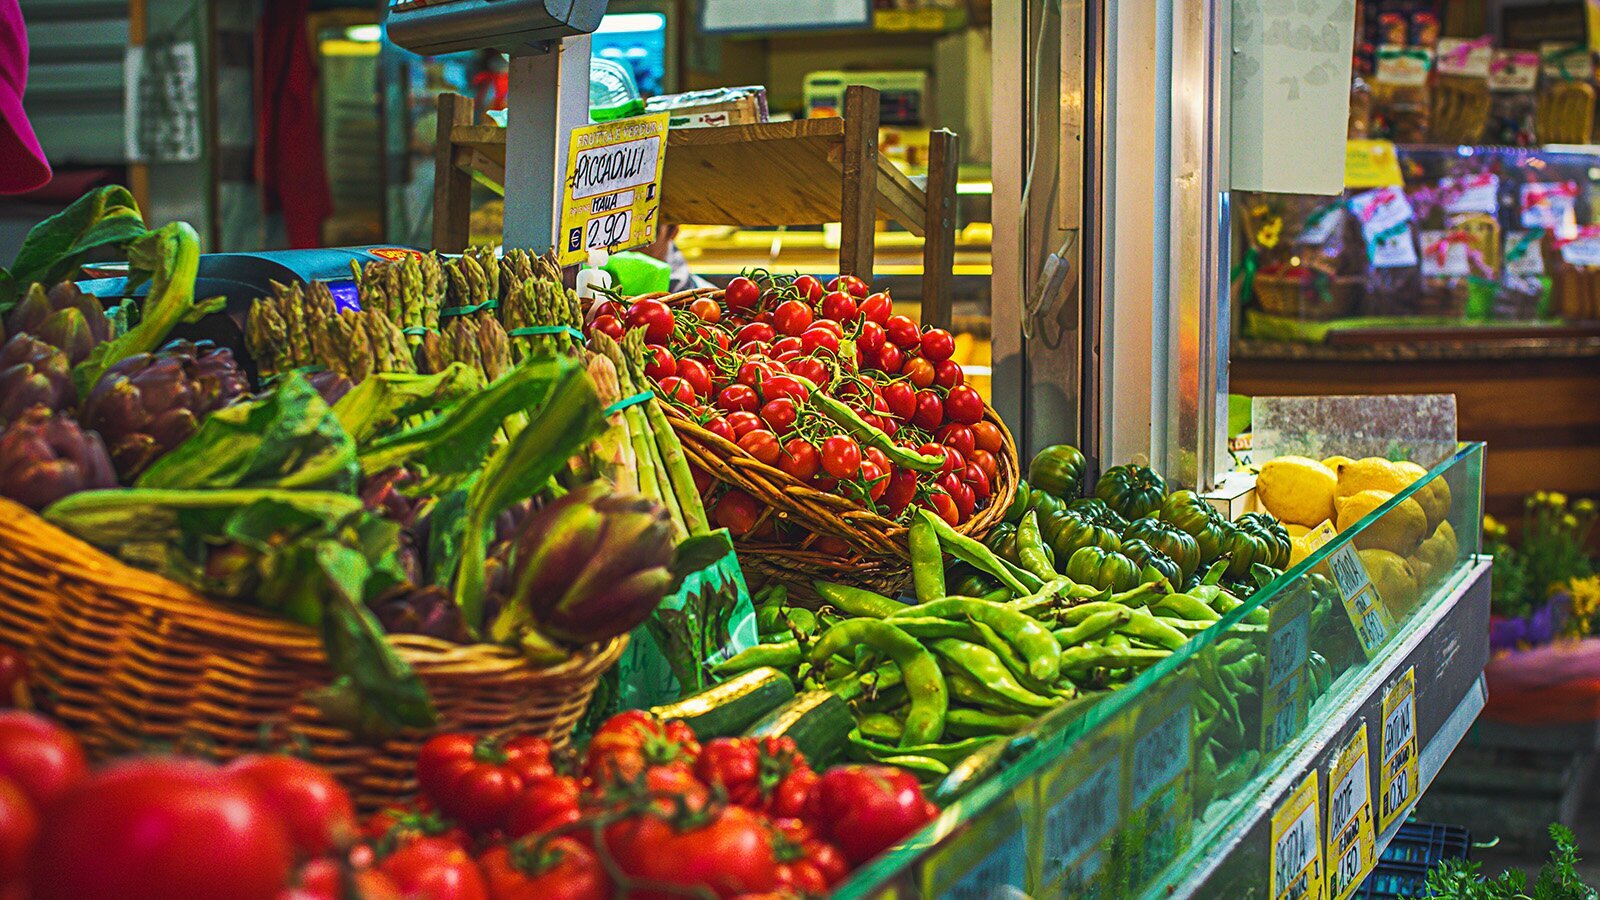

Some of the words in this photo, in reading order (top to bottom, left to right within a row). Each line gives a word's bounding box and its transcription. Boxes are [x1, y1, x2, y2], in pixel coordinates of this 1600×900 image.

[576, 130, 613, 148] FRUTTA
[615, 127, 621, 141] E
[623, 121, 663, 139] VERDURA
[588, 211, 627, 248] 2.90
